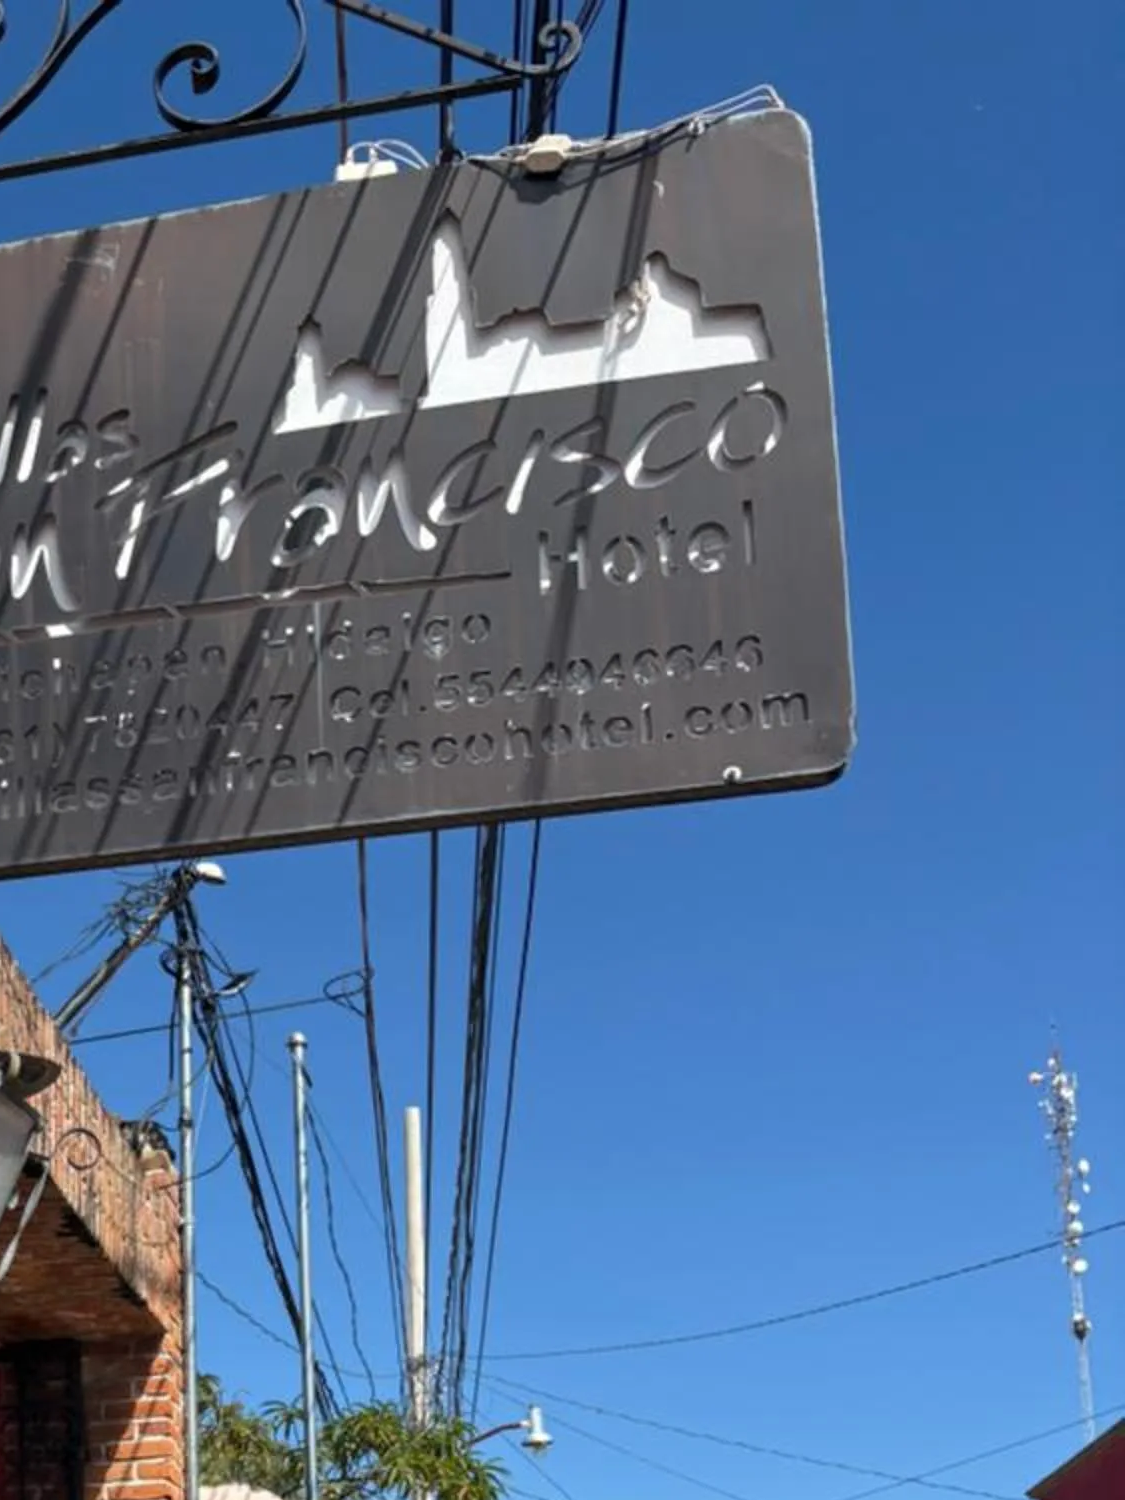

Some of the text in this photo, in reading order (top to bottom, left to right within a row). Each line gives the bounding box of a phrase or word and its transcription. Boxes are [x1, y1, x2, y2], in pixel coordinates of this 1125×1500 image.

[94, 381, 789, 580] Francisco
[536, 499, 756, 596] Hotel
[261, 611, 493, 668] Hidalgo
